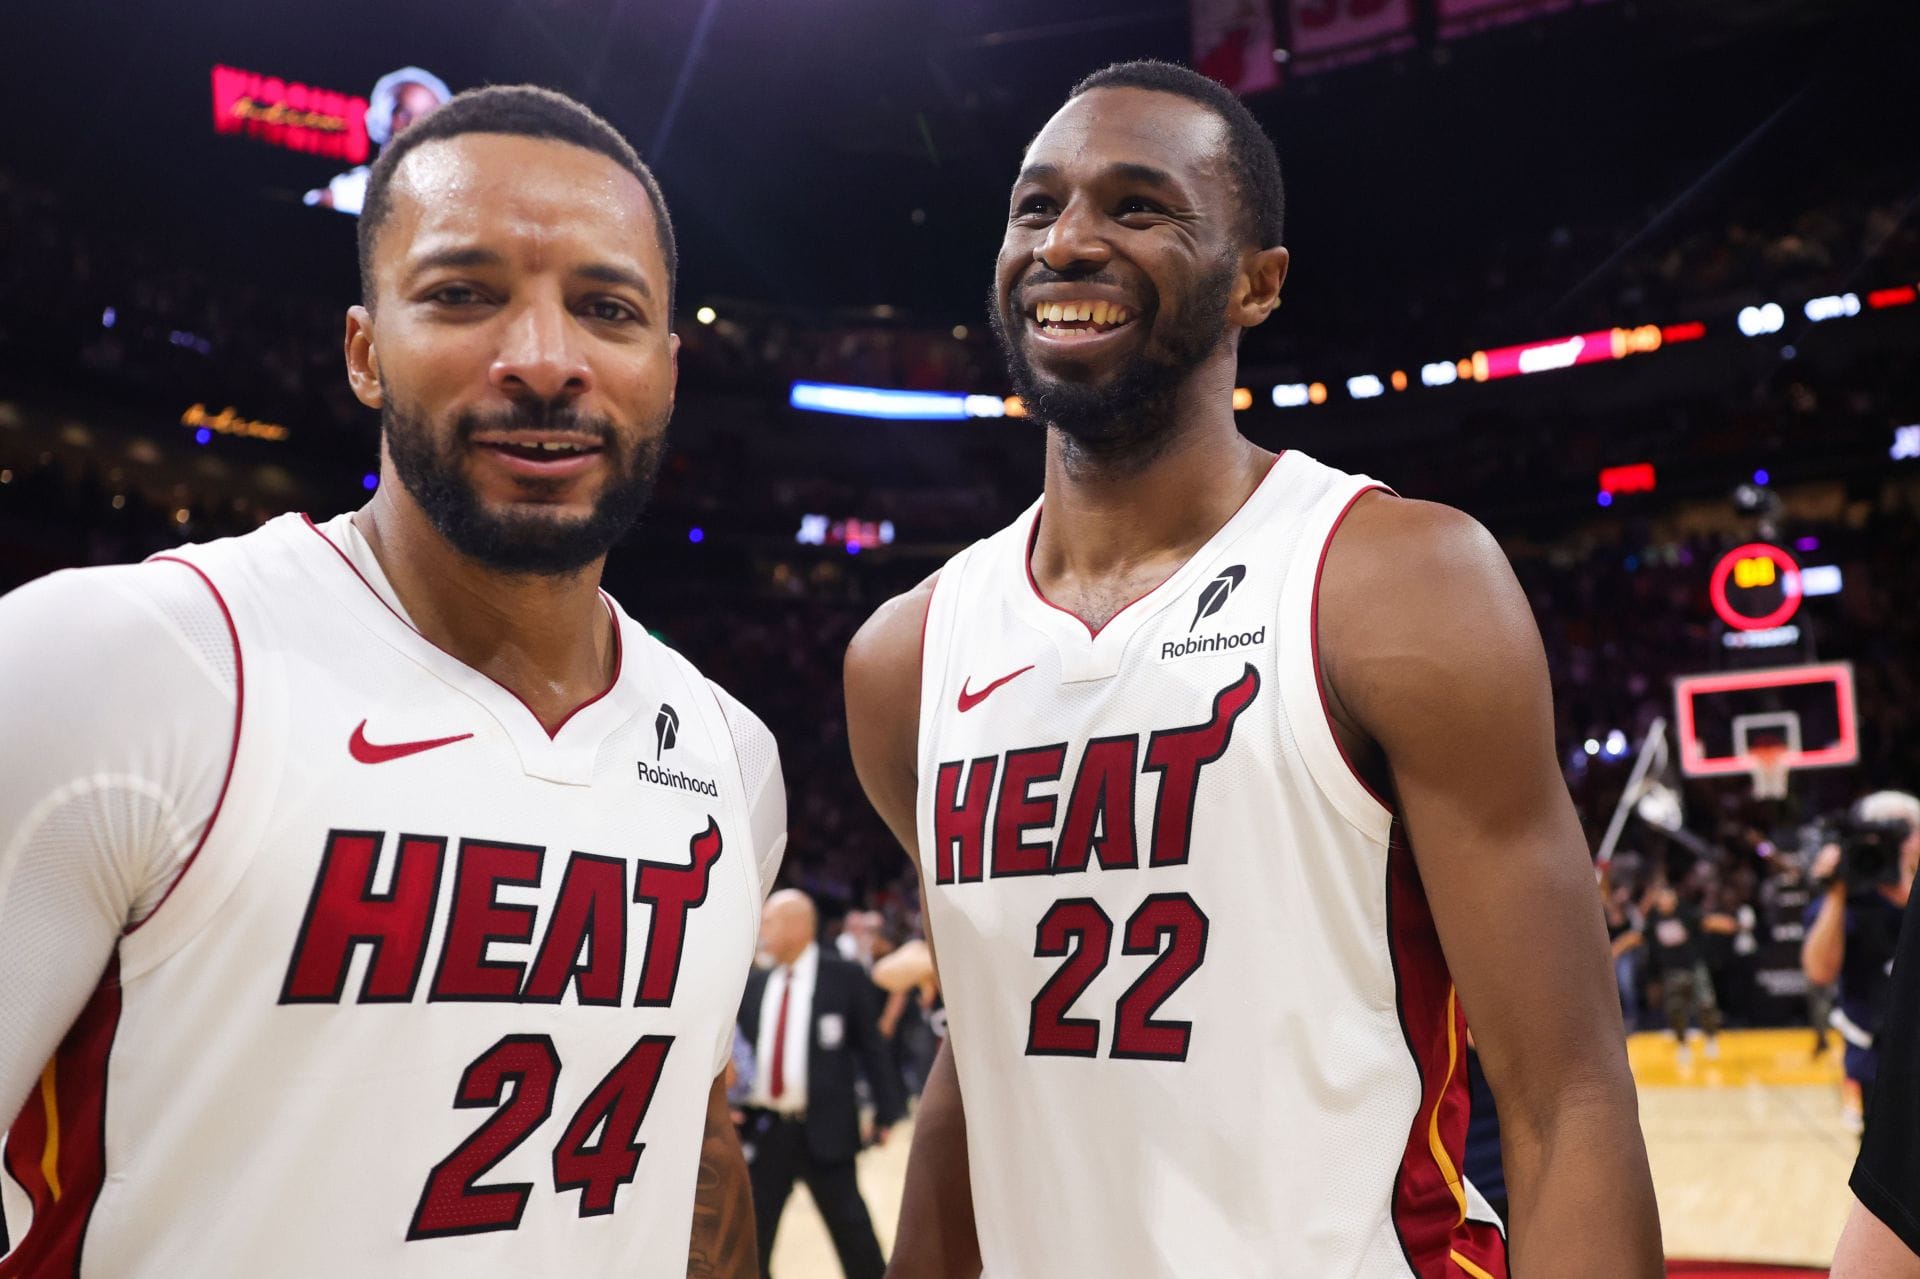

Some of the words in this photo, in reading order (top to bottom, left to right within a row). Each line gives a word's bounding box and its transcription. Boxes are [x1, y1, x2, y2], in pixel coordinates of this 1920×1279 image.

[1161, 625, 1265, 660] Robinhood
[637, 761, 718, 797] Robinhood
[935, 662, 1261, 885] HEAT
[277, 814, 723, 1008] HEAT
[1025, 892, 1210, 1062] 22
[405, 1033, 676, 1241] 24
